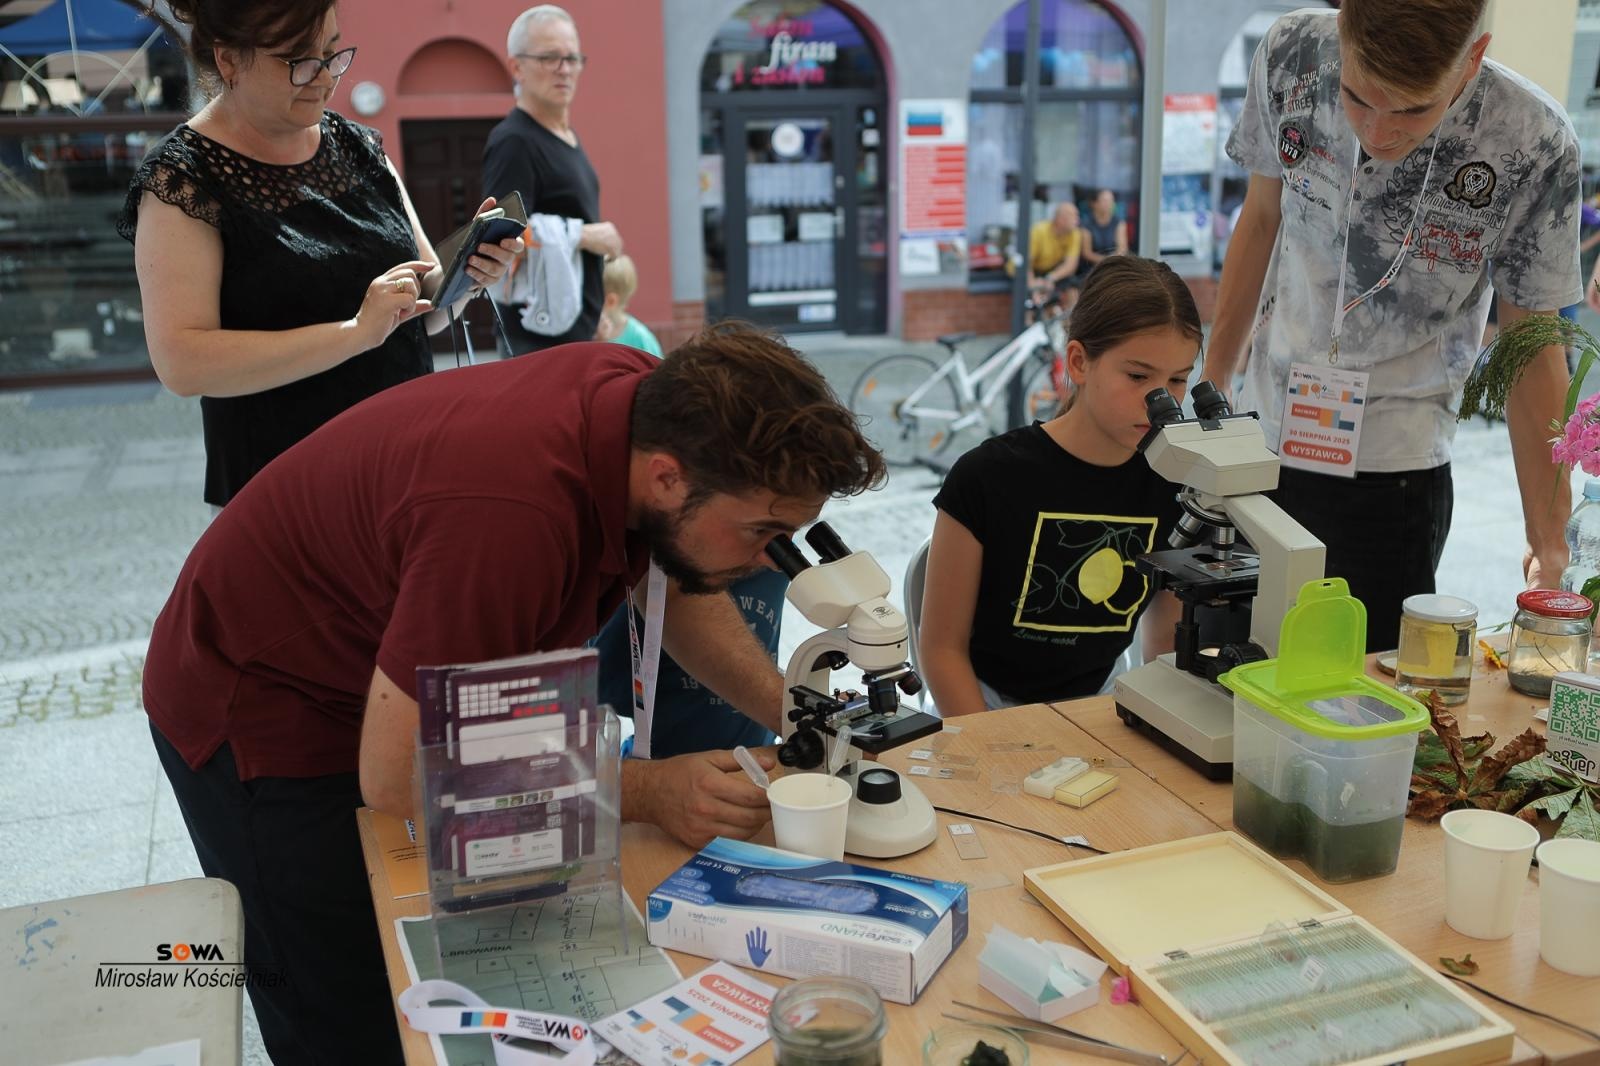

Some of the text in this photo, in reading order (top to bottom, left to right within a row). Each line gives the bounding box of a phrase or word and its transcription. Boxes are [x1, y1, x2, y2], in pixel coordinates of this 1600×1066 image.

[1281, 141, 1299, 160] 1878
[1299, 430, 1332, 442] SIERPNIA
[1333, 436, 1351, 445] 2025
[1290, 444, 1344, 461] WYSTAWCA
[711, 978, 771, 1014] YSTAWCA
[542, 1018, 588, 1042] OWA
